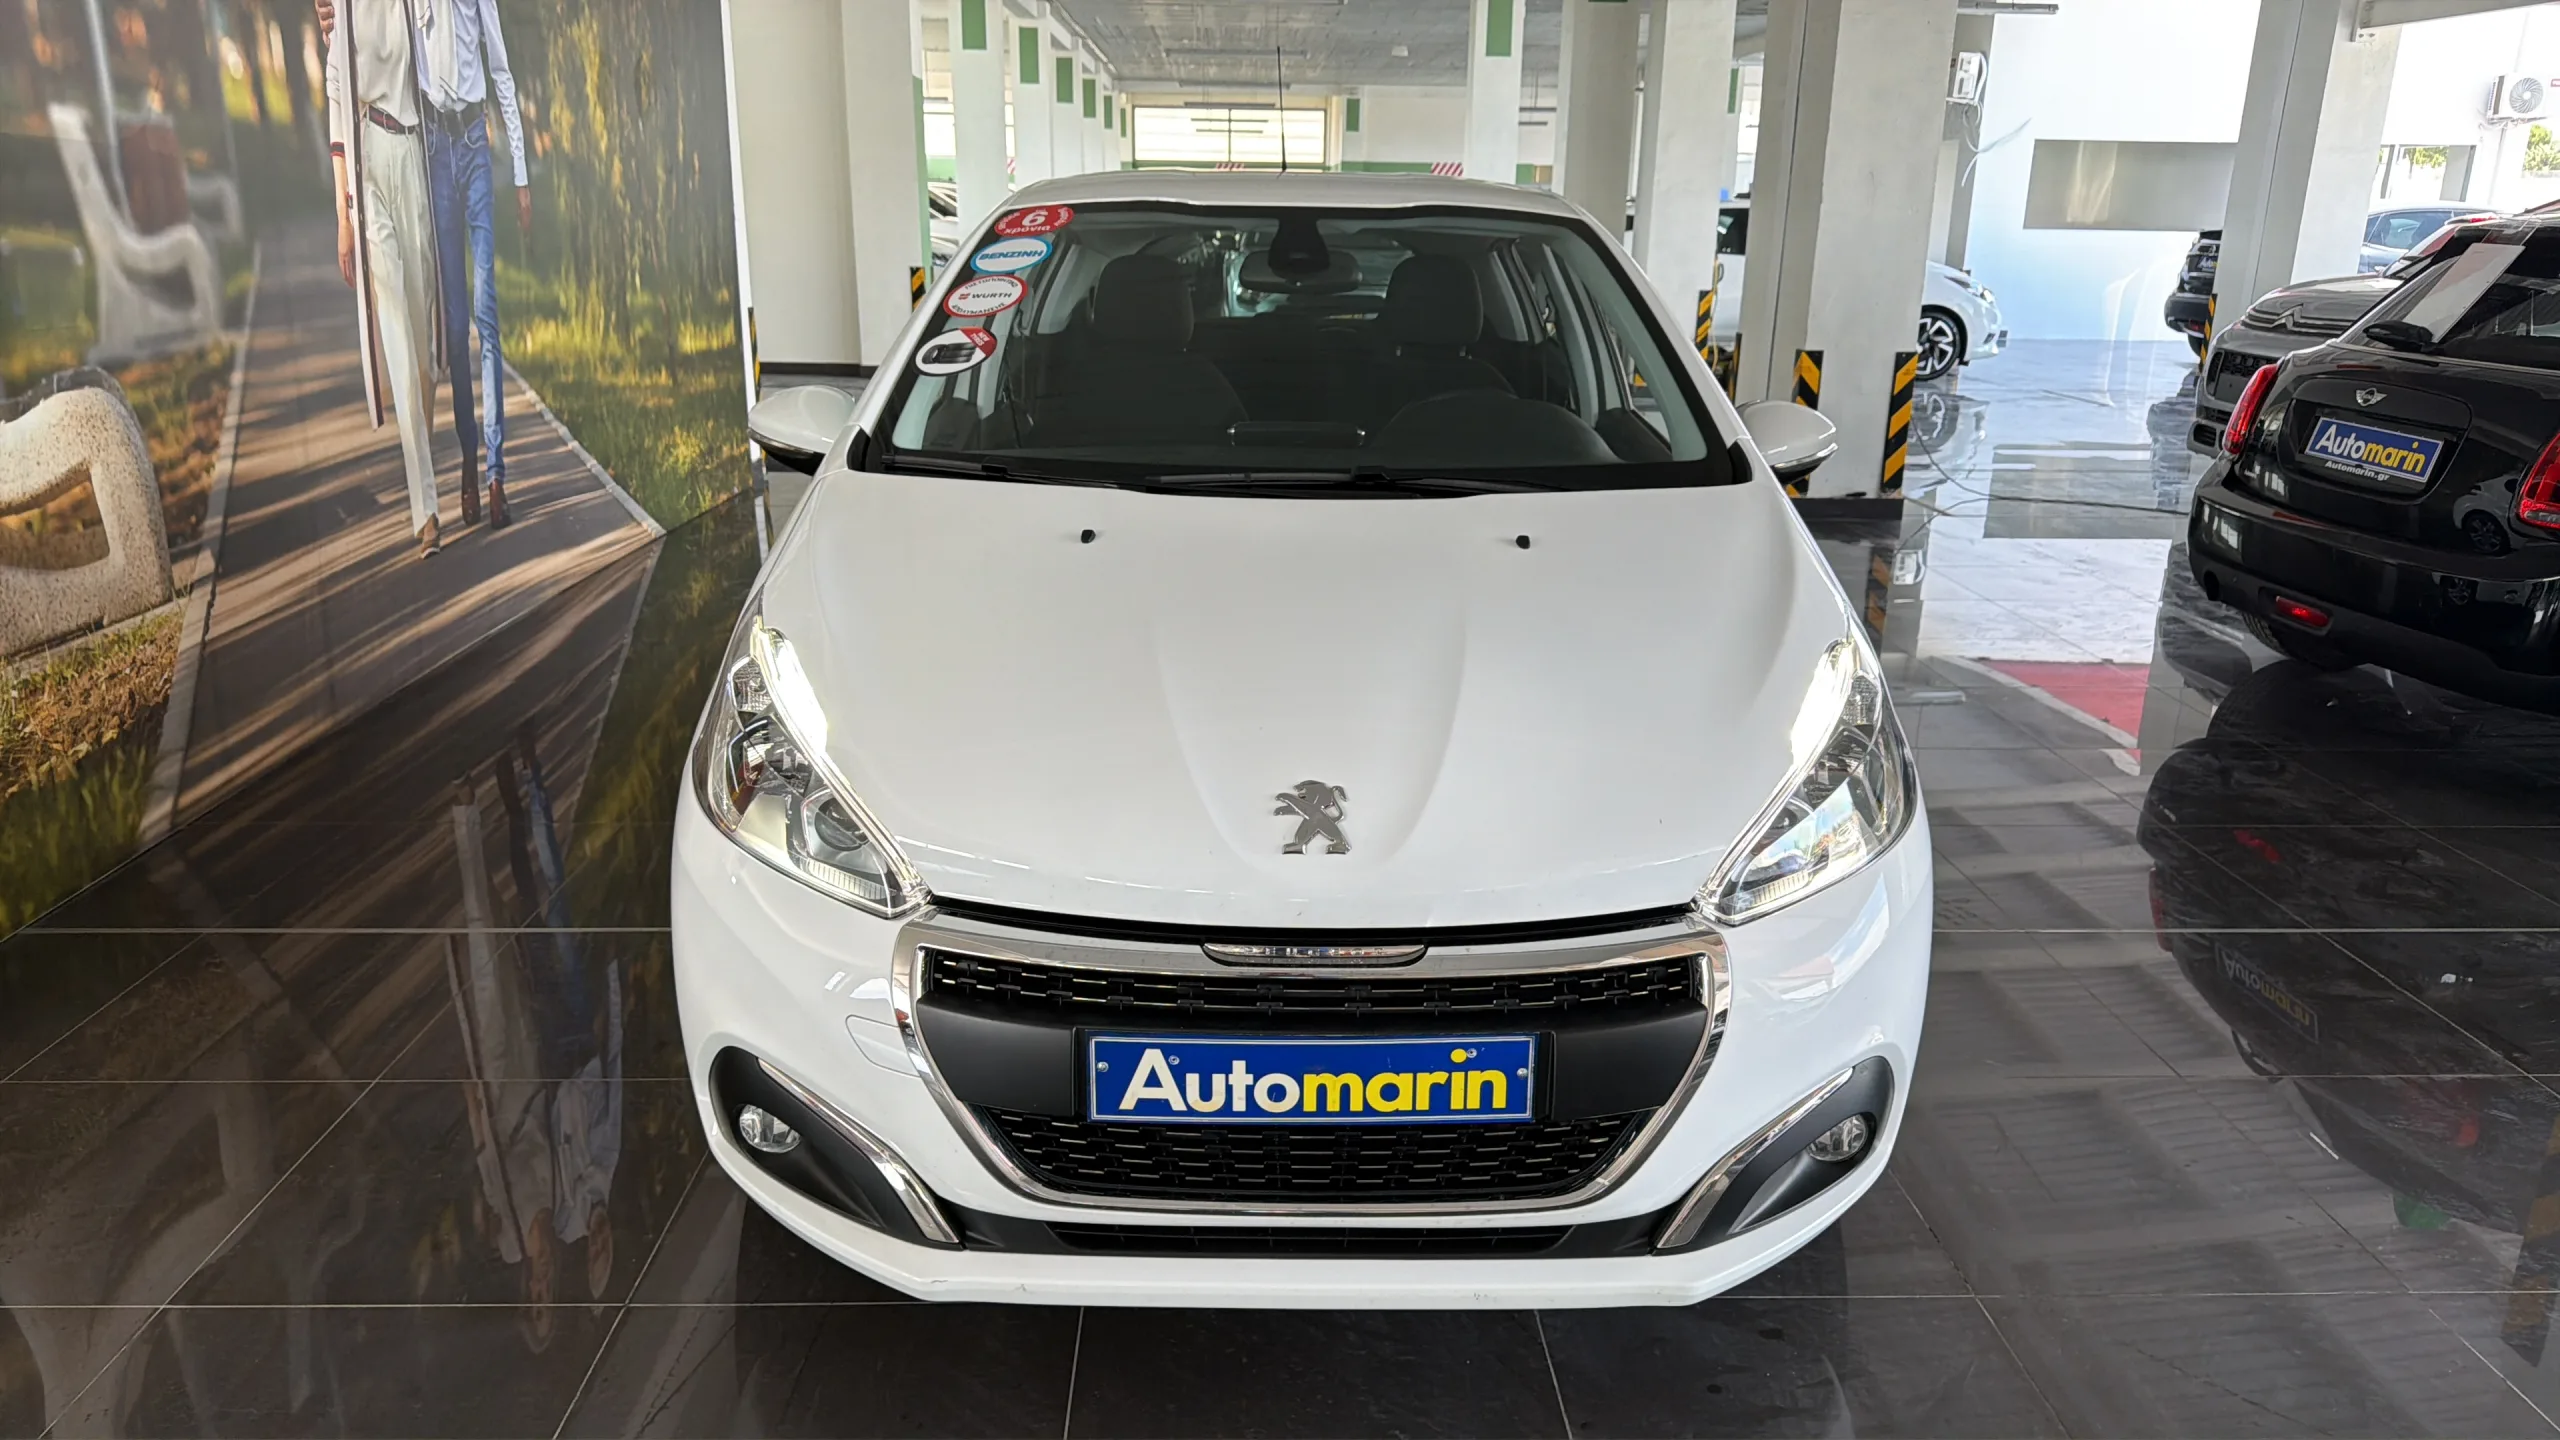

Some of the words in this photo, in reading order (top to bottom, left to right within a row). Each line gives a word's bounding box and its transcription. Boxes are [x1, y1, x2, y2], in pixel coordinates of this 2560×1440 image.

[1021, 210, 1049, 227] 6
[2314, 423, 2426, 473] Automarin
[2324, 460, 2391, 481] Automarin.gr
[1118, 1048, 1507, 1113] Automarin
